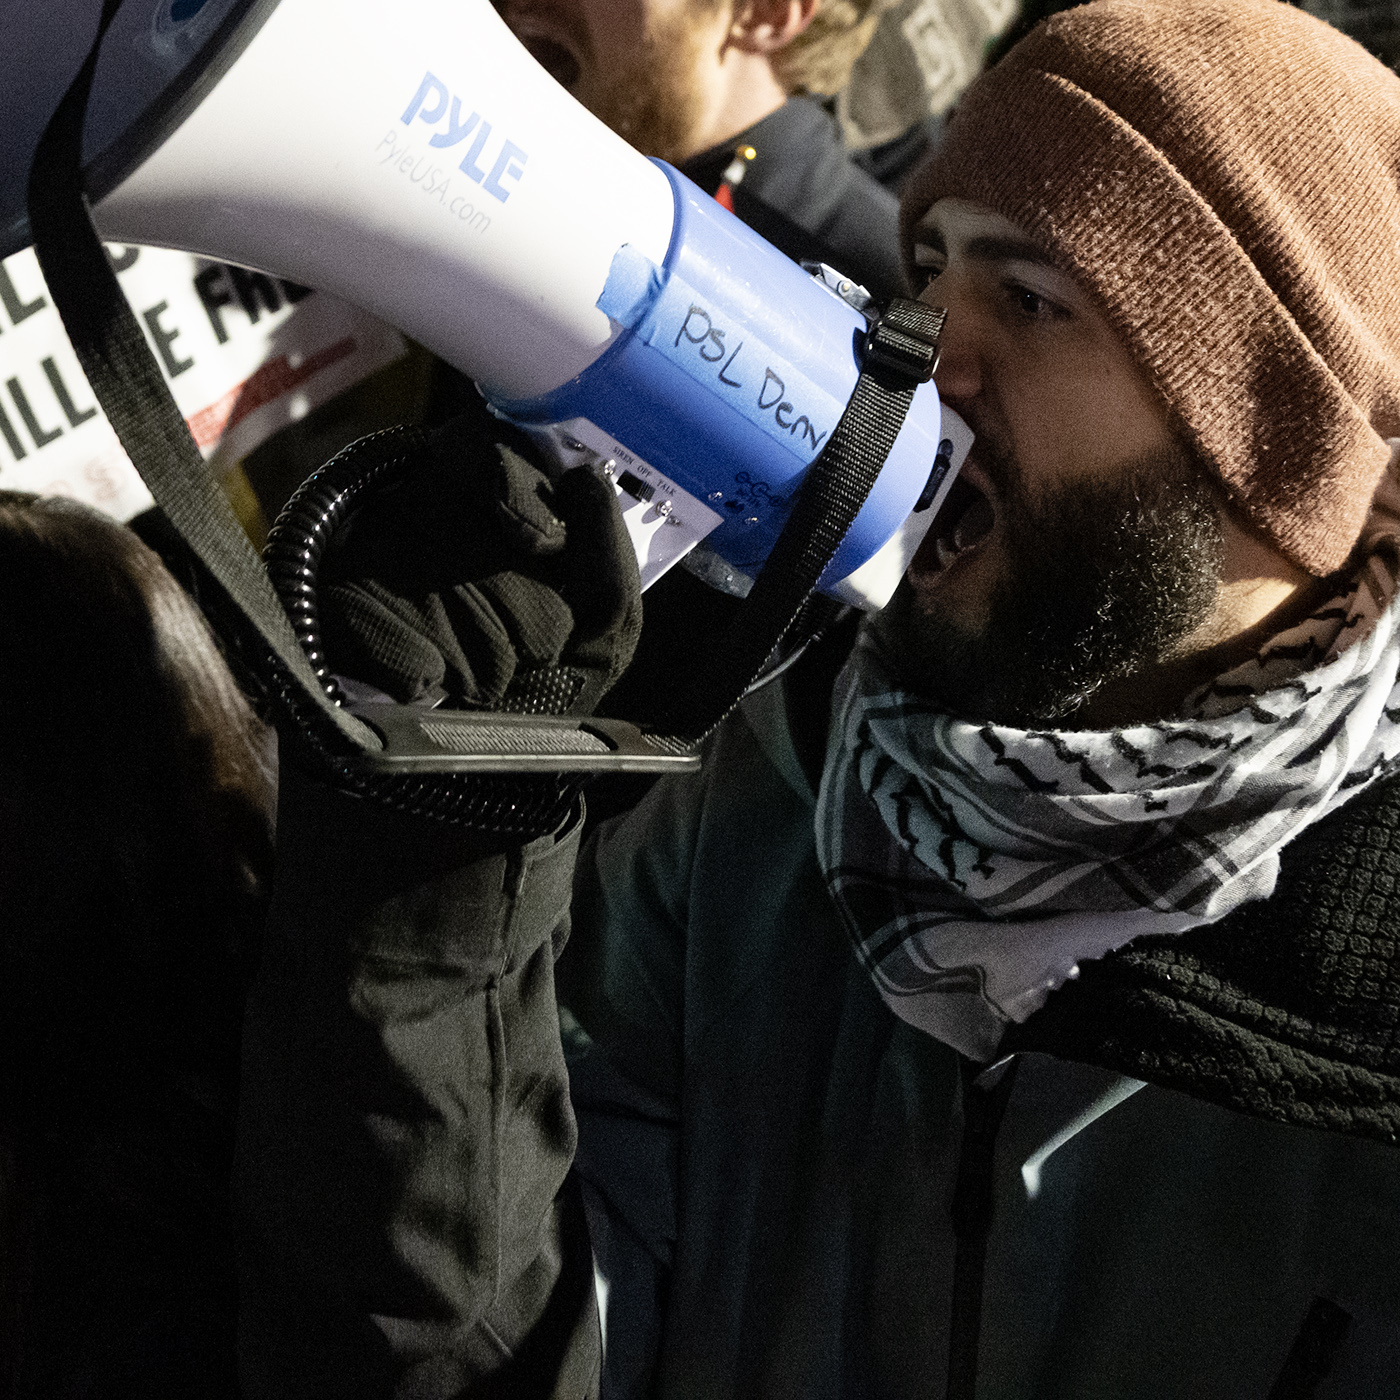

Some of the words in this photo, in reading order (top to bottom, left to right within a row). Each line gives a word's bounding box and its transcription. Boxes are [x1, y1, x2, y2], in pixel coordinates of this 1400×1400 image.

[374, 129, 492, 234] PyleUSA.com
[142, 299, 196, 379] E
[674, 302, 743, 389] PSL
[612, 446, 636, 466] SIREN
[636, 464, 653, 479] OFF
[656, 478, 678, 498] TALK
